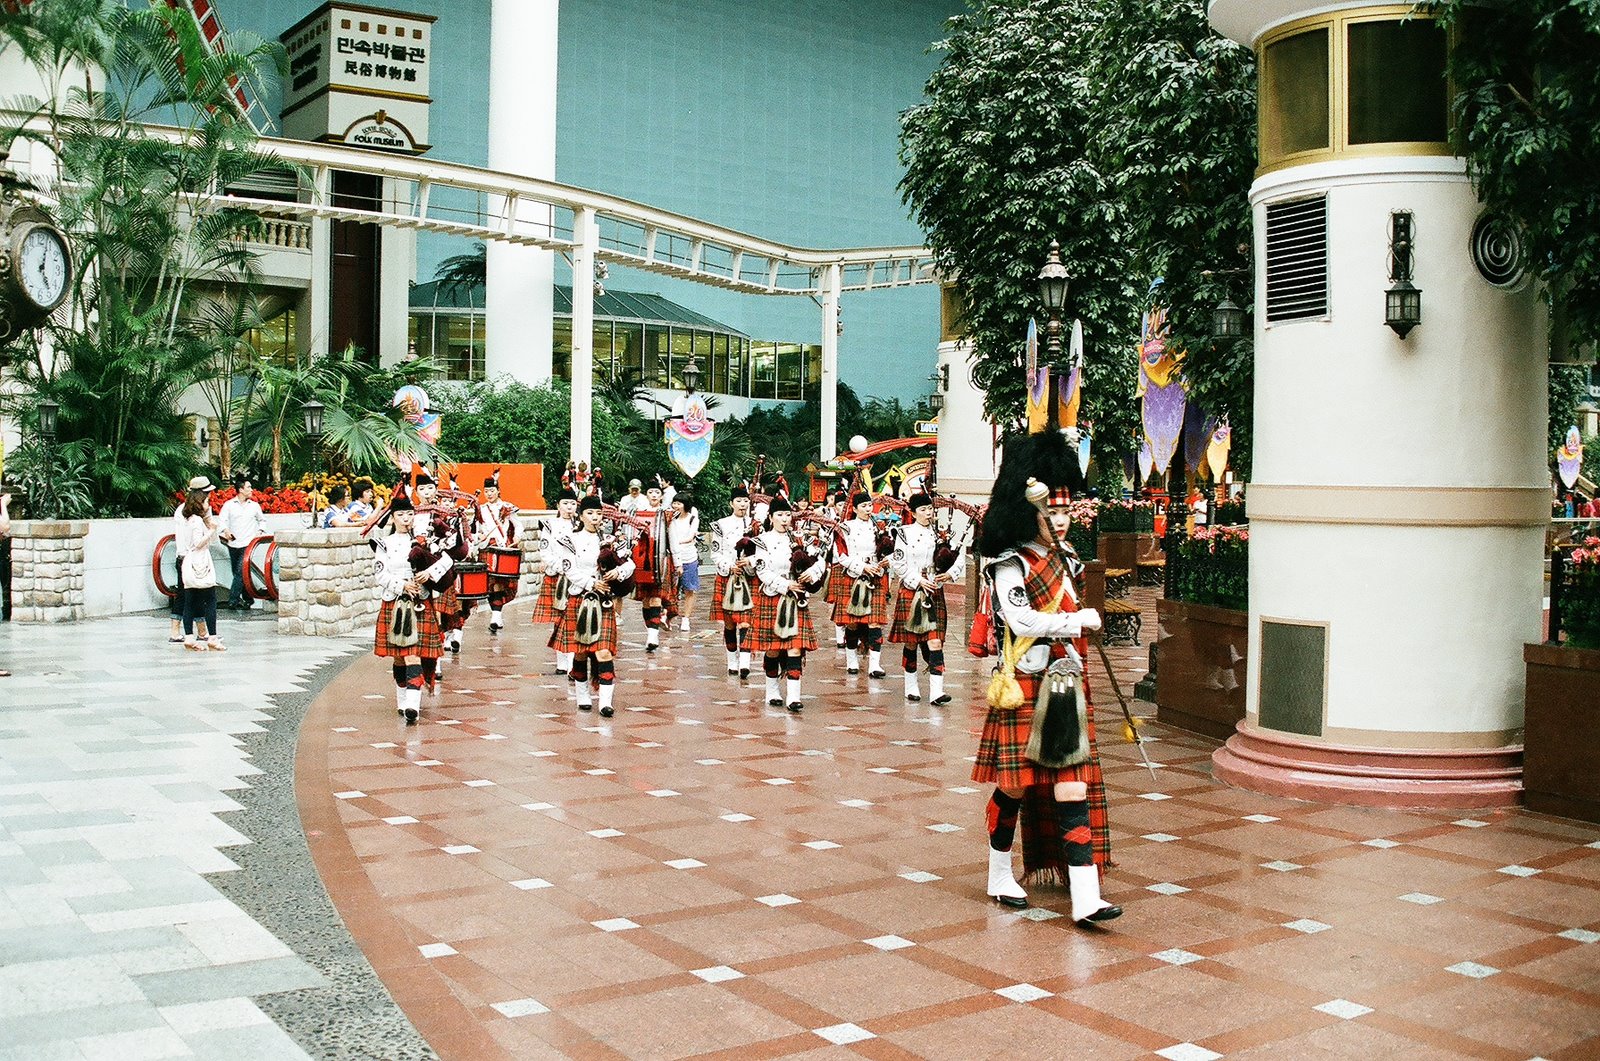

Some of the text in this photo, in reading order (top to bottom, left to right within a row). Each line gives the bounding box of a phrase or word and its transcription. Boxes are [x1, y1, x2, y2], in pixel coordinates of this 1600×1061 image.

[337, 37, 425, 63] 민속박물관
[344, 60, 416, 82] 民俗博物館
[354, 134, 373, 144] FOLK
[37, 233, 45, 246] 12
[53, 250, 59, 262] 2
[55, 264, 60, 276] 3
[687, 407, 704, 422] 20
